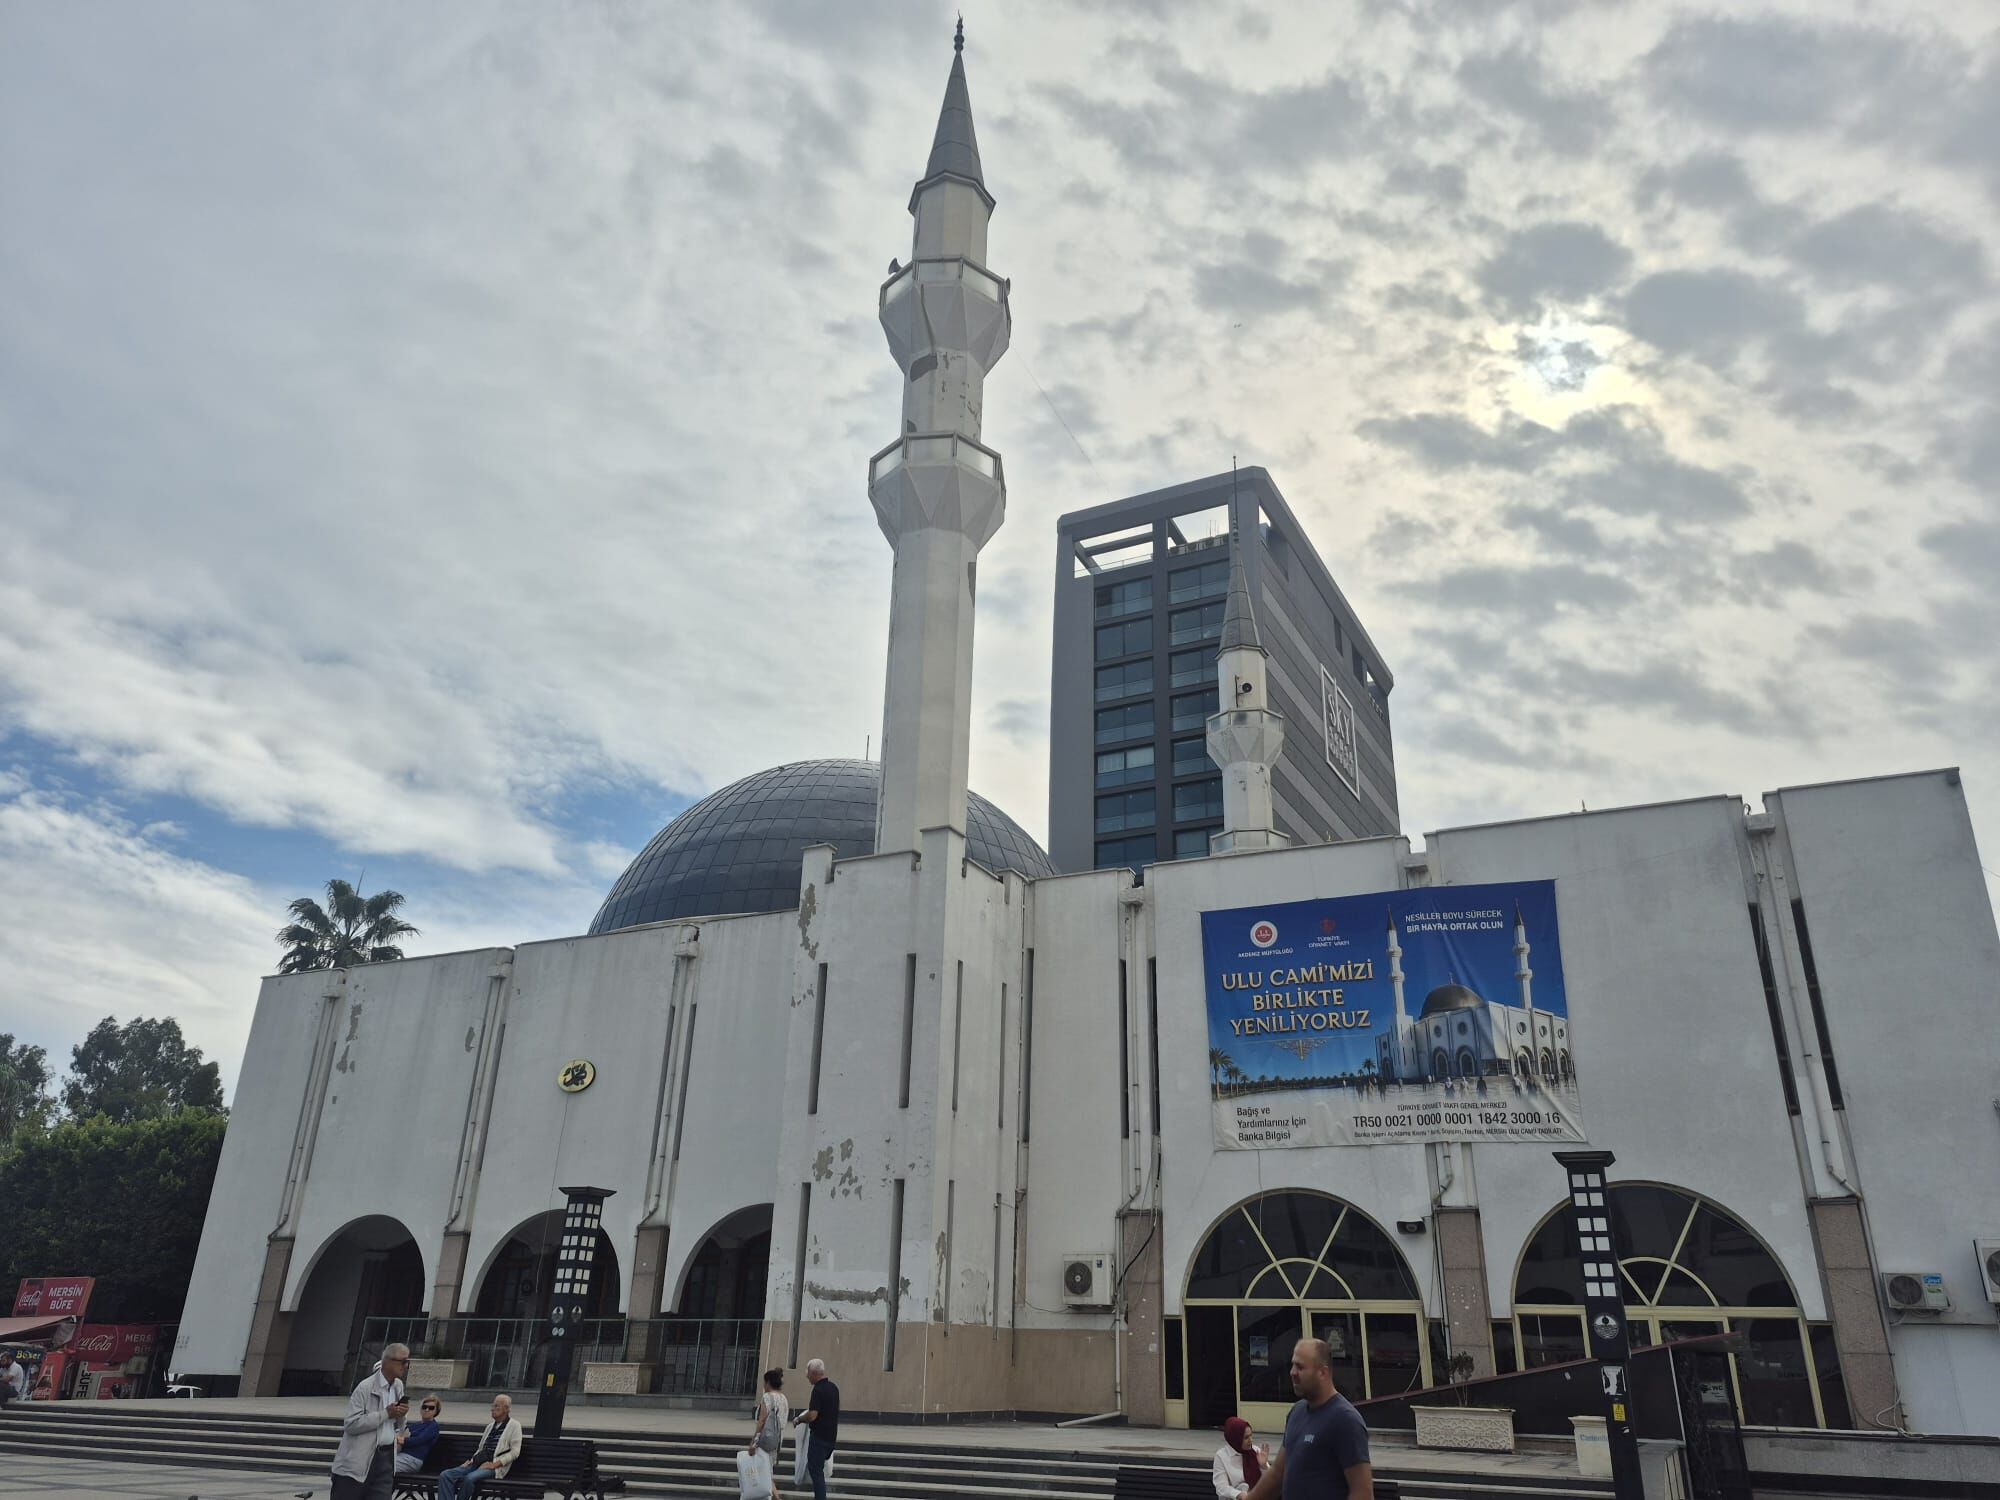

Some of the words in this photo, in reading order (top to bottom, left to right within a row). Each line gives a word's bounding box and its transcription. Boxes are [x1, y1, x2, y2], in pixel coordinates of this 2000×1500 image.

[1405, 911, 1441, 922] NESİLLER
[1443, 911, 1463, 920] BOYU
[1465, 910, 1502, 919] SÜRECEK
[1406, 923, 1420, 933] BİR
[1421, 922, 1449, 931] HAYRA
[1450, 921, 1478, 930] ORTAK
[1480, 920, 1503, 929] OLUN
[1222, 971, 1262, 990] ULU
[1270, 958, 1374, 986] CAMİ'MİZİ
[1252, 987, 1344, 1011] BİRLİKTE
[1230, 1010, 1371, 1036] YENİLİYORUZ
[1236, 1107, 1259, 1117] Bağış
[1261, 1107, 1271, 1115] ve
[1237, 1118, 1289, 1129] Yardımlarınız
[1291, 1115, 1306, 1128] İçin
[1352, 1116, 1382, 1128] TR50
[1385, 1114, 1412, 1127] 0021
[1417, 1112, 1442, 1126] 0000
[1445, 1112, 1472, 1125] 0001
[1478, 1112, 1508, 1125] 1842
[1511, 1111, 1541, 1124] 3000
[1545, 1112, 1561, 1124] 16
[1238, 1132, 1264, 1142] Banka
[1265, 1130, 1291, 1141] Bilgisi
[48, 1284, 83, 1296] MERSİN
[50, 1298, 74, 1309] BÜFE
